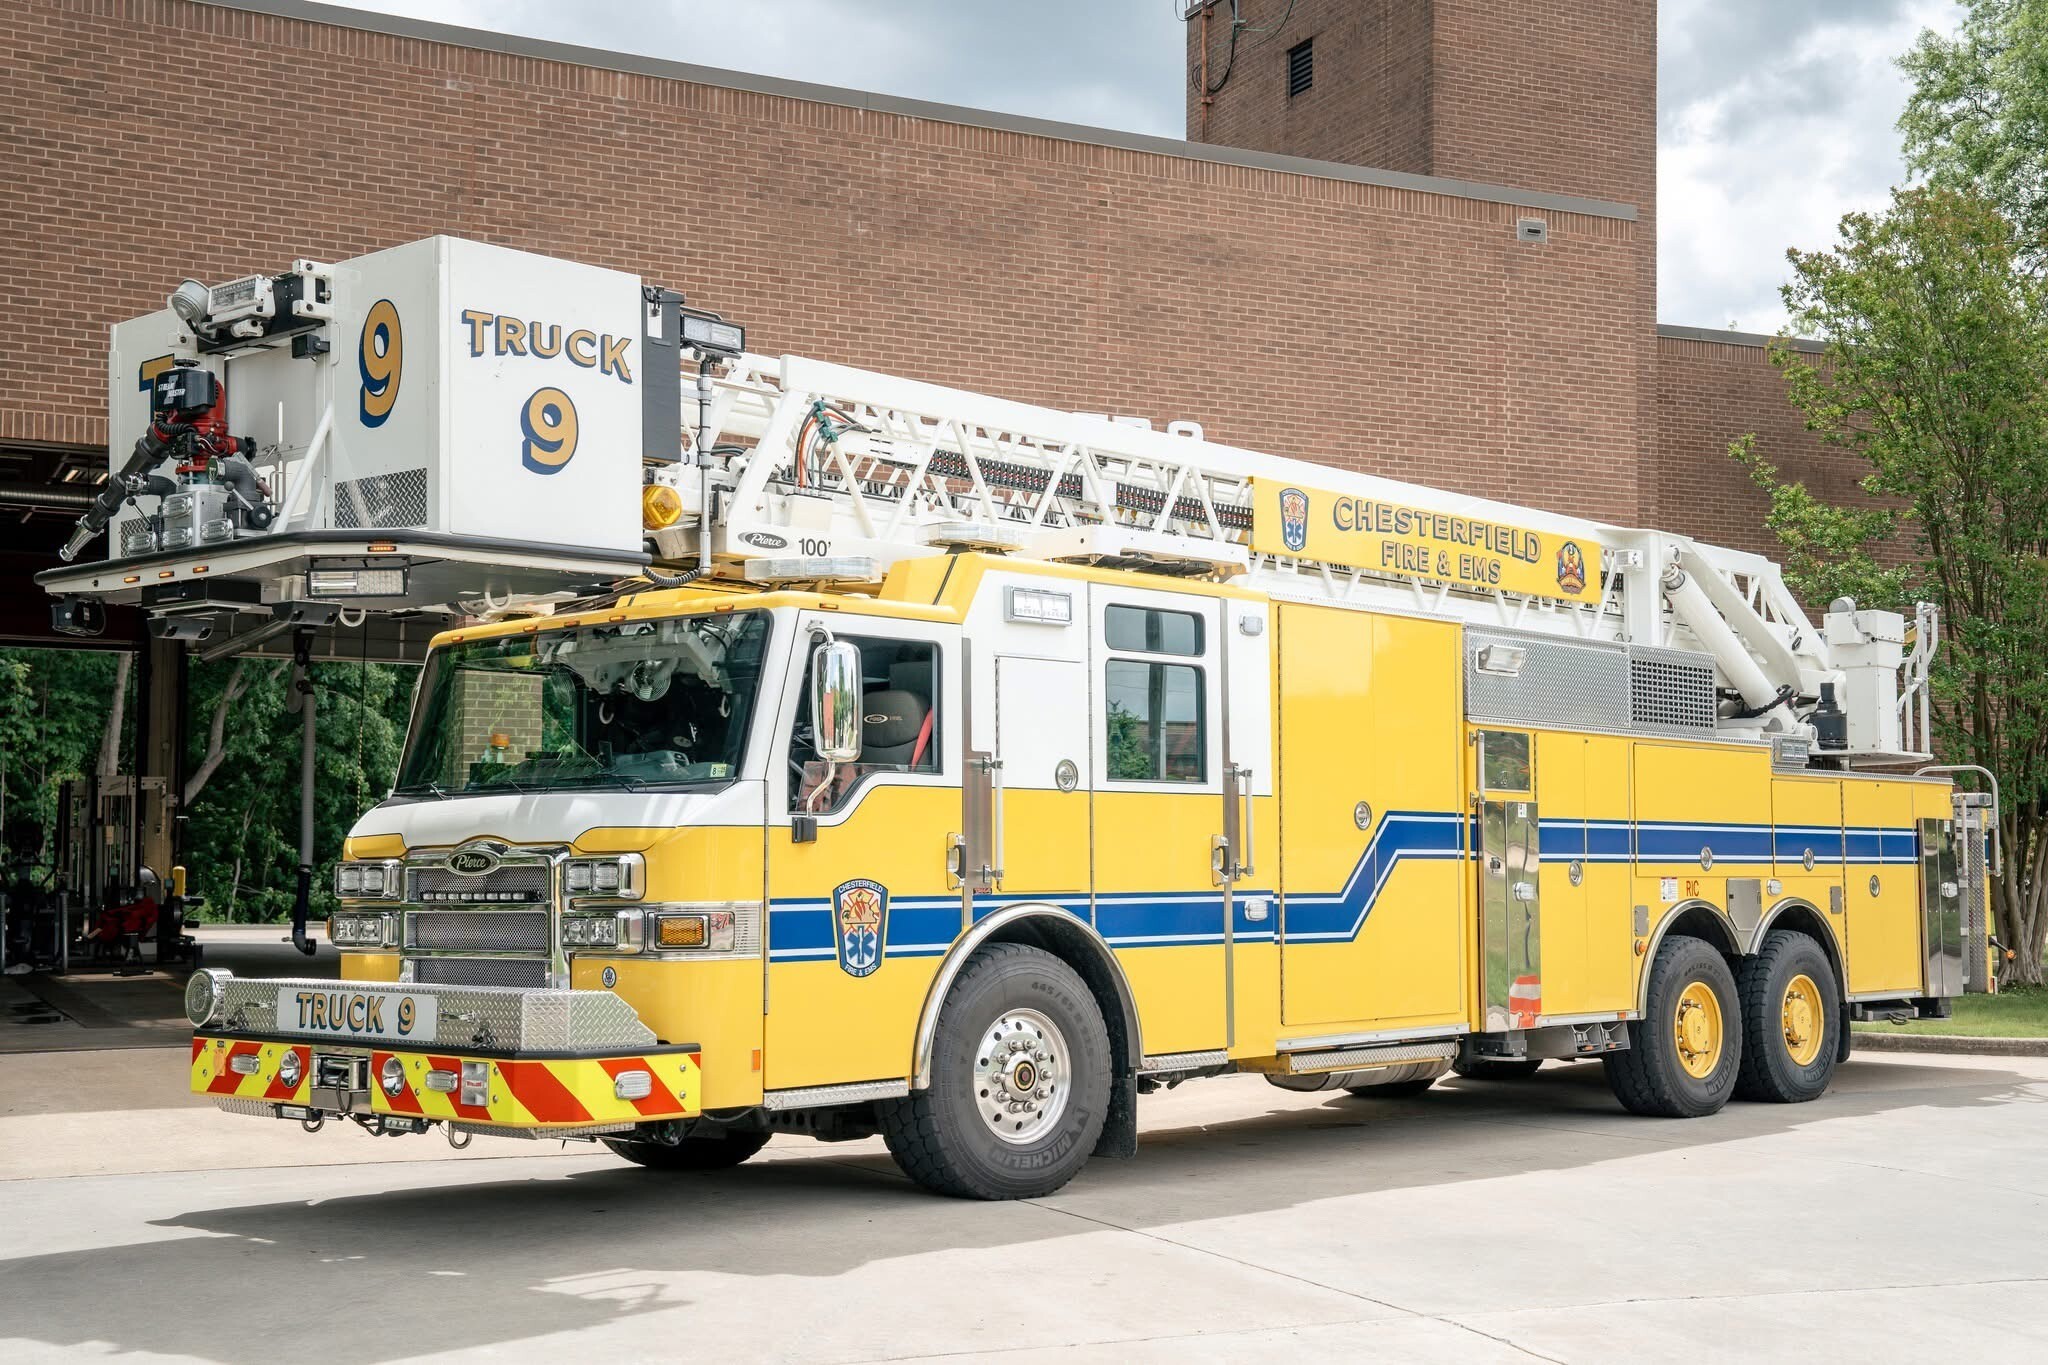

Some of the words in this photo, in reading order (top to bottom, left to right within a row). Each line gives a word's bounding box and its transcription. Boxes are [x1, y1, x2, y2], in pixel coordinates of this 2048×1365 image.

[359, 298, 402, 428] 9
[461, 309, 633, 385] TRUCK
[520, 386, 579, 476] 9
[750, 533, 783, 548] Pierce
[1333, 496, 1542, 564] CHESTERFIELD
[1381, 540, 1430, 574] FIRE
[1437, 549, 1451, 576] &
[1459, 553, 1501, 585] EMS
[456, 854, 487, 871] Pierce
[838, 880, 883, 893] CHESTERFIELD
[1685, 879, 1700, 897] RIC
[845, 965, 857, 976] FIRE
[864, 964, 877, 975] EMS
[296, 991, 386, 1034] TRUCK
[397, 996, 416, 1036] 9
[991, 1130, 1073, 1168] MICHELIN
